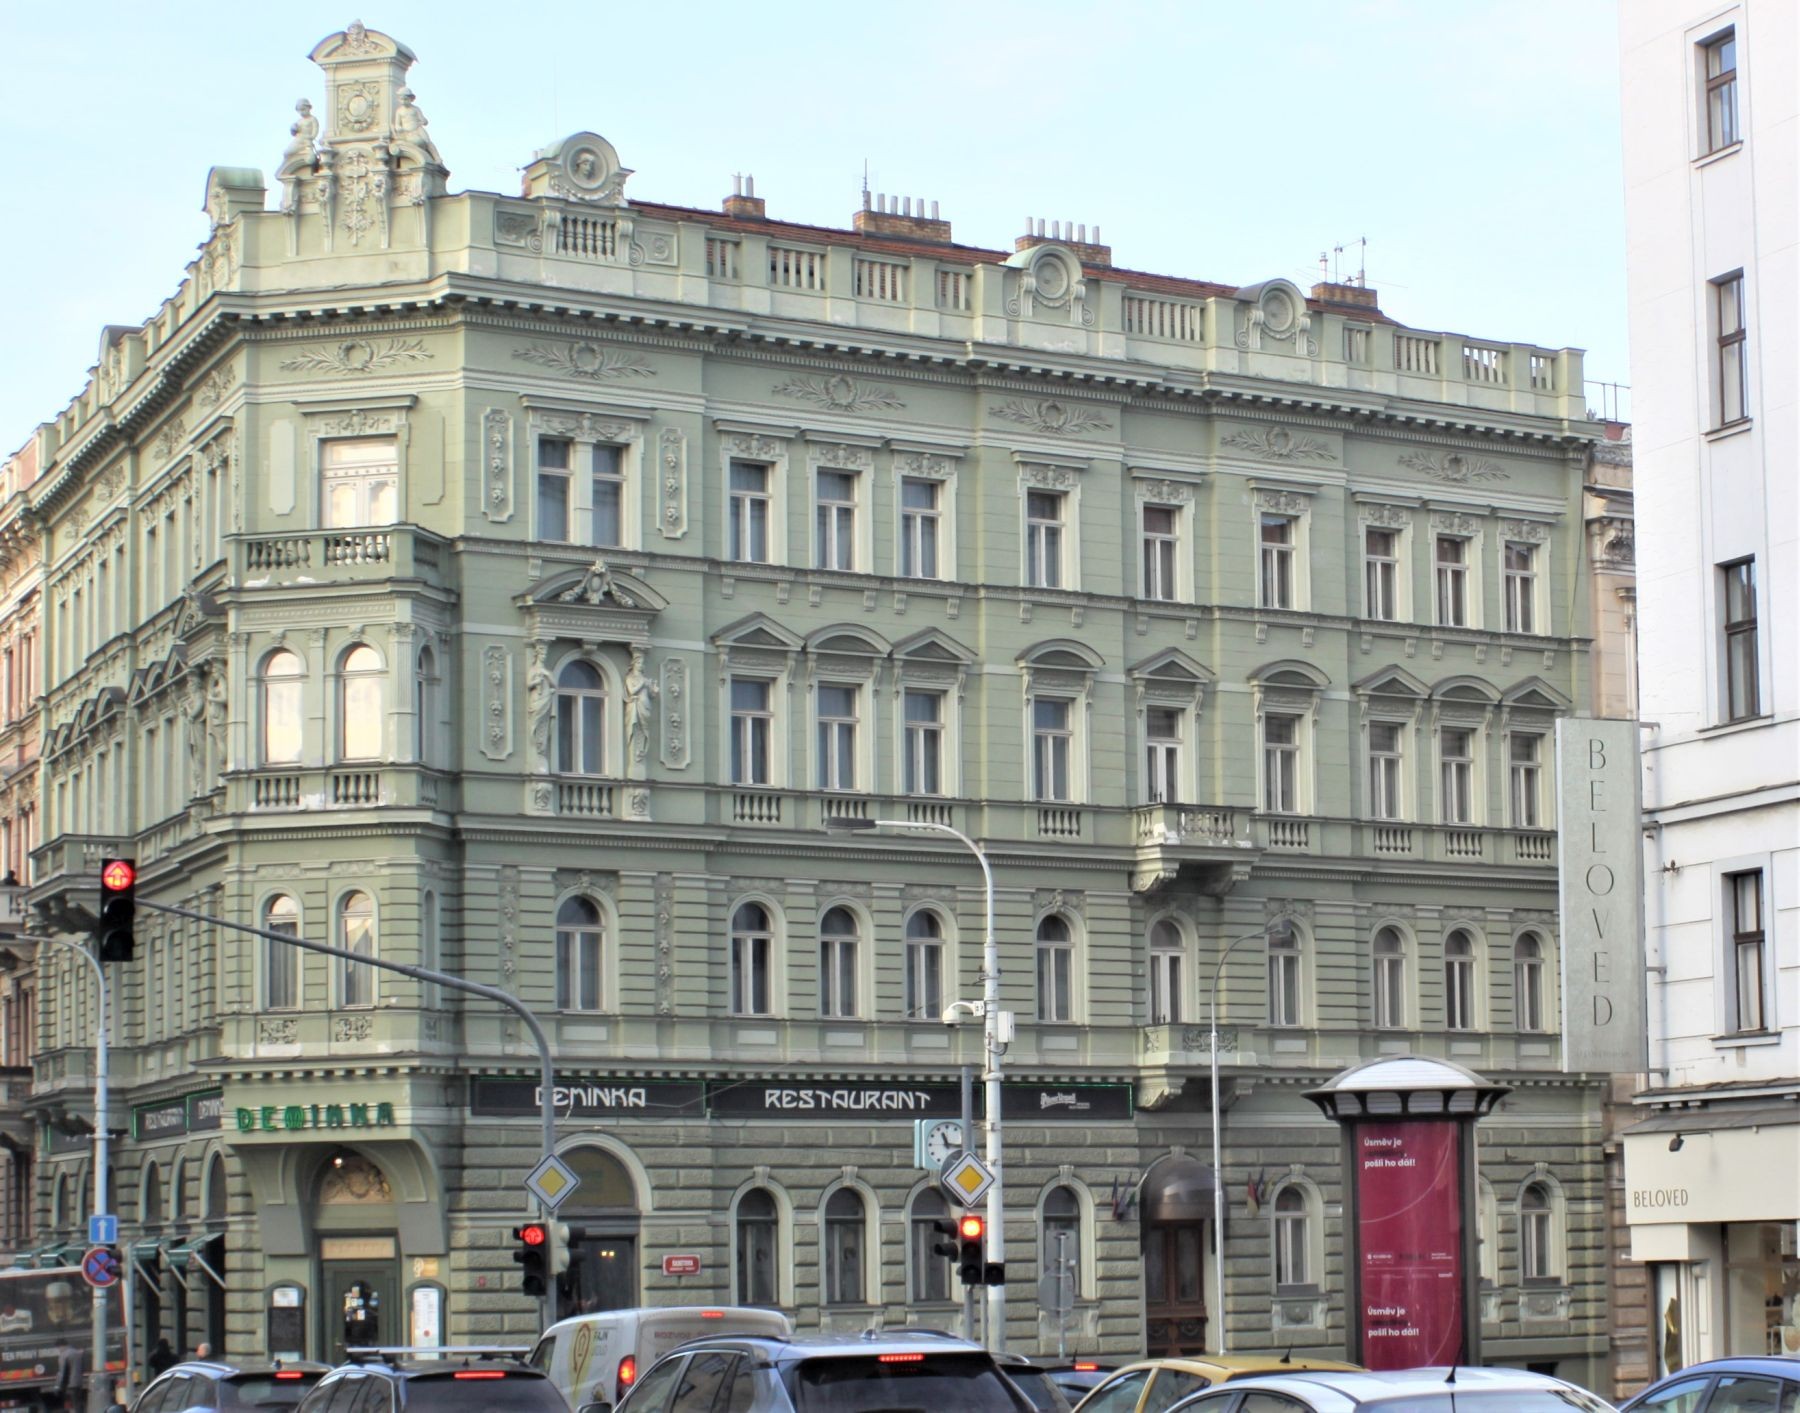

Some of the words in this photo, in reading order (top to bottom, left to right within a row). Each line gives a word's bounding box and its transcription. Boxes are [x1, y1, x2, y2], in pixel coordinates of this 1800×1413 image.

[1586, 738, 1614, 1027] BELOVED
[764, 1089, 932, 1110] RESTAURANT
[236, 1102, 395, 1132] DEMINKA
[1393, 1137, 1402, 1149] je
[1364, 1158, 1384, 1170] pošli
[1385, 1159, 1396, 1167] ho
[1633, 1188, 1689, 1208] BELOVED
[1396, 1306, 1406, 1318] je
[1388, 1328, 1400, 1336] ho
